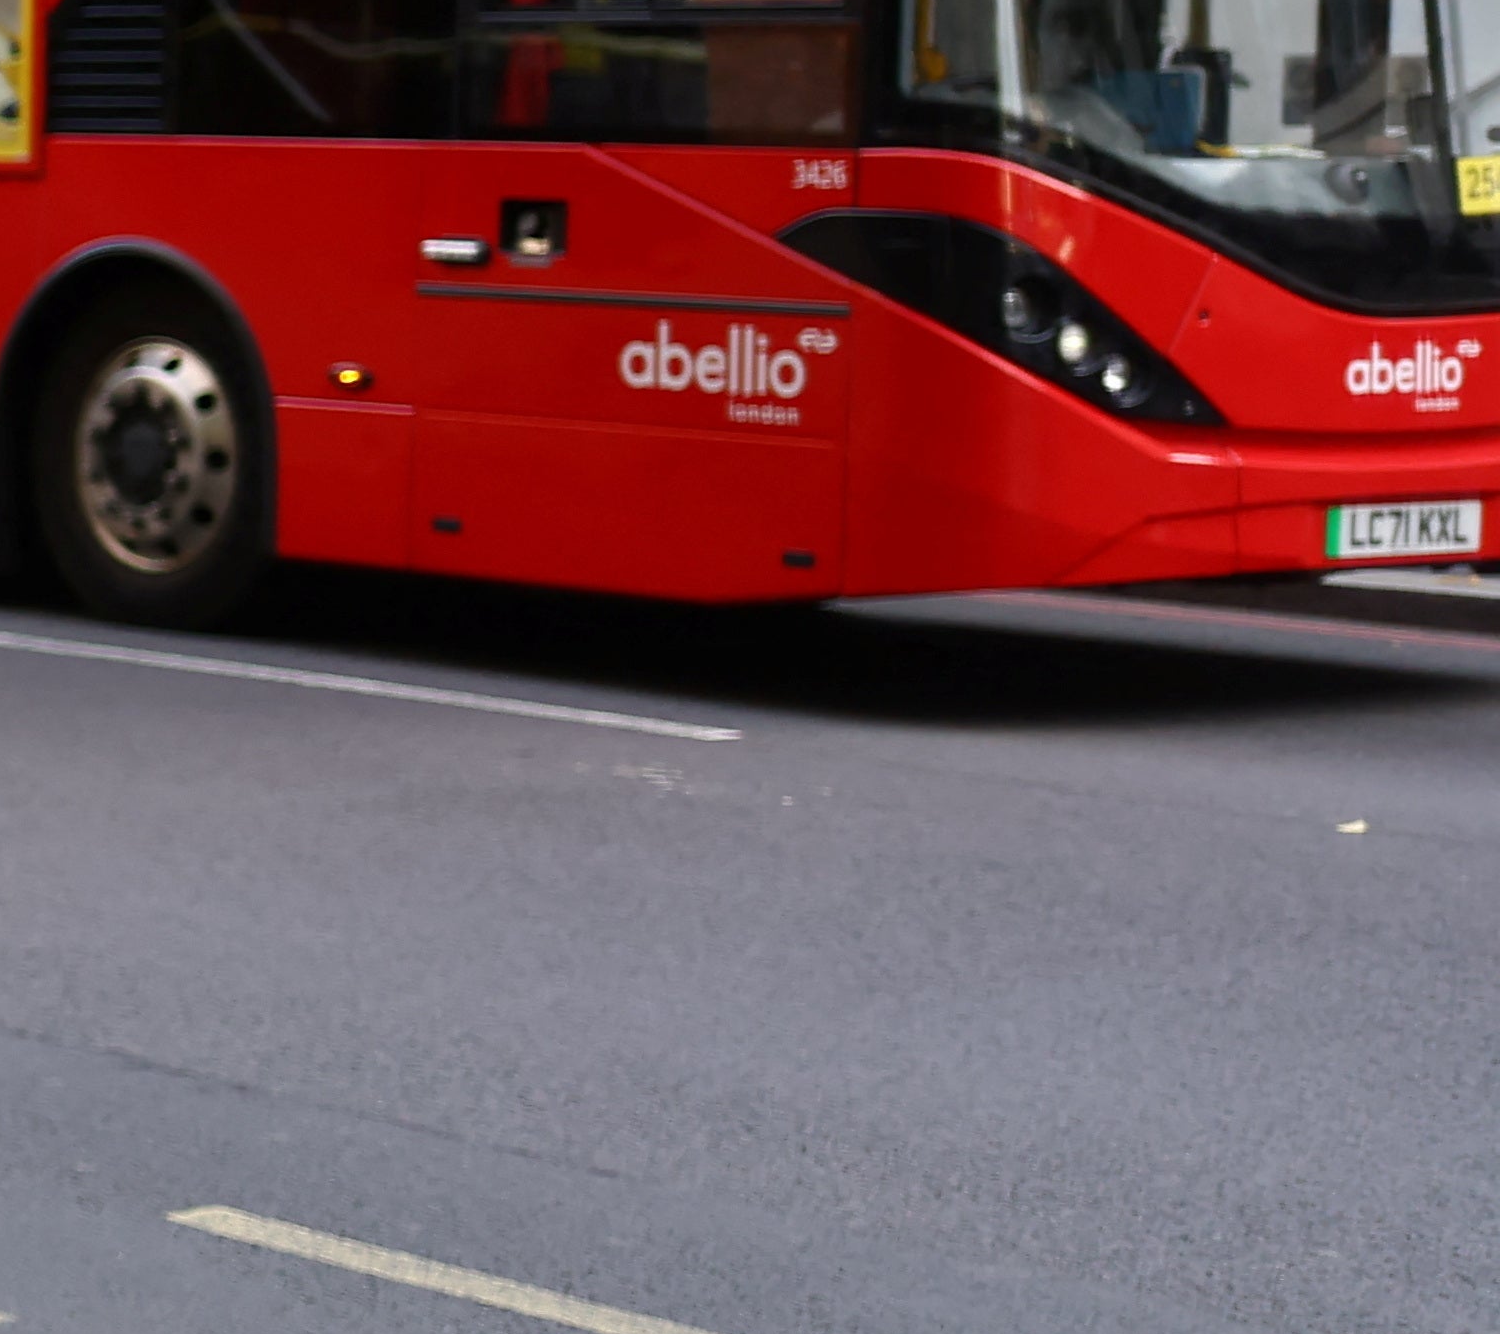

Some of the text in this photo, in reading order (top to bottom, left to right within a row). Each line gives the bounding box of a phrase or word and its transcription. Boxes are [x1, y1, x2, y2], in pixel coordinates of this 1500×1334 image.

[790, 159, 847, 189] 3426
[618, 319, 806, 399] abellio
[1346, 340, 1463, 395] abellio
[727, 400, 800, 426] london
[1350, 507, 1467, 547] LC71 KXL
